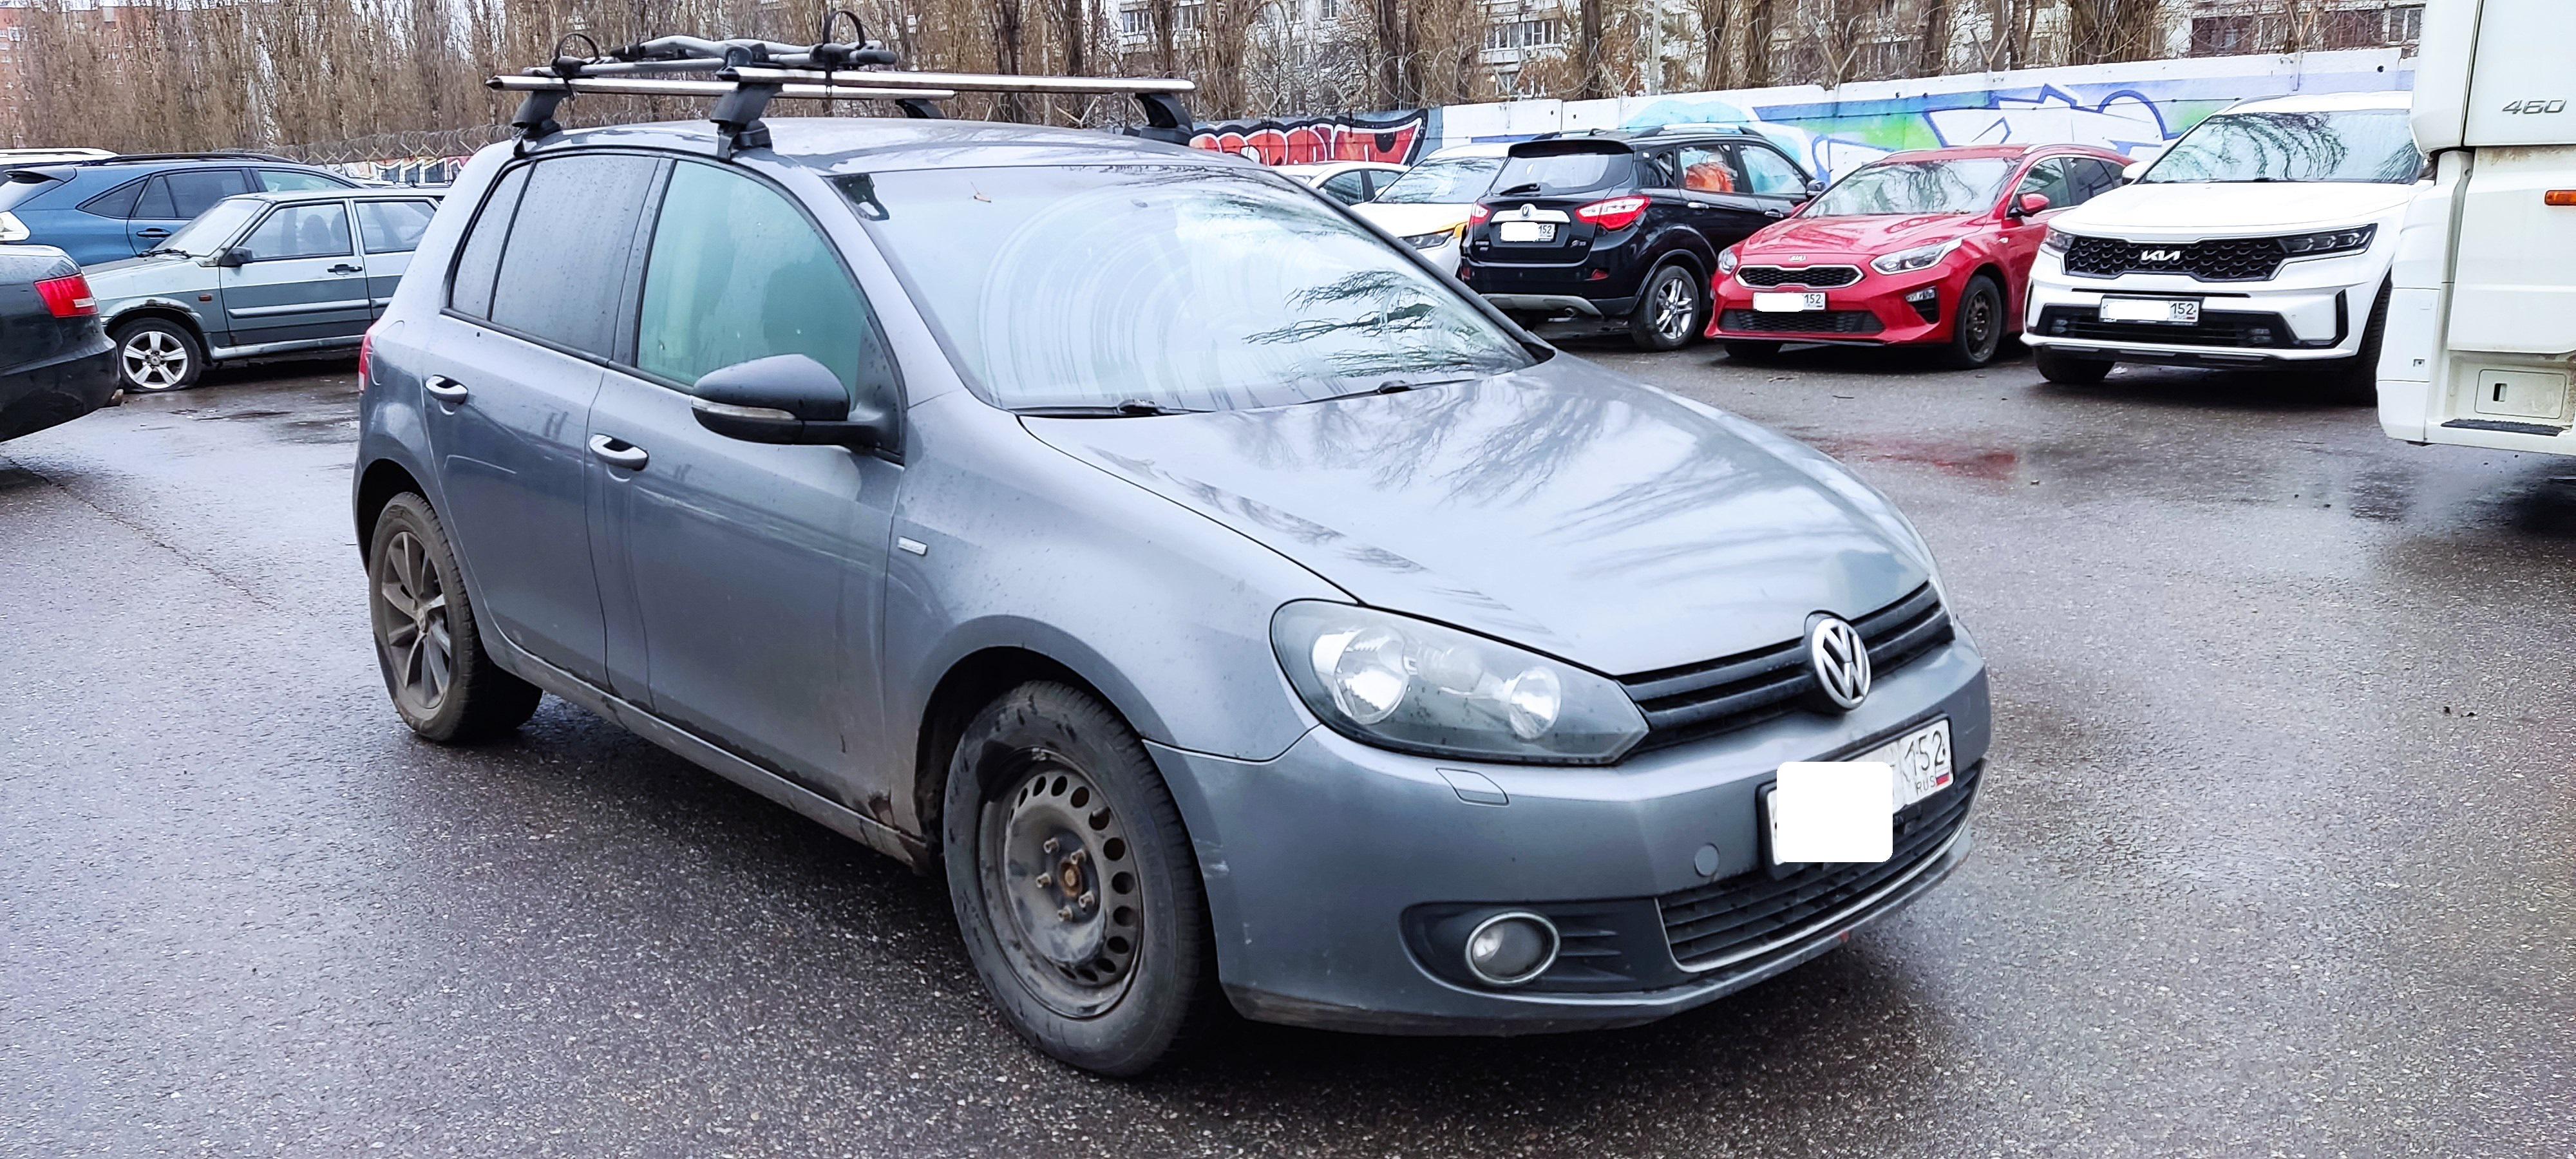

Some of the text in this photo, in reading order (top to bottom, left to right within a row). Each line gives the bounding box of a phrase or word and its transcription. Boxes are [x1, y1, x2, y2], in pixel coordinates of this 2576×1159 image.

[2502, 100, 2567, 115] 460
[1539, 225, 1552, 234] 152
[2141, 249, 2181, 261] KIA
[1804, 294, 1821, 304] 152
[2170, 303, 2194, 315] 152
[1904, 730, 1944, 777] 152
[1916, 775, 1936, 793] RUS
